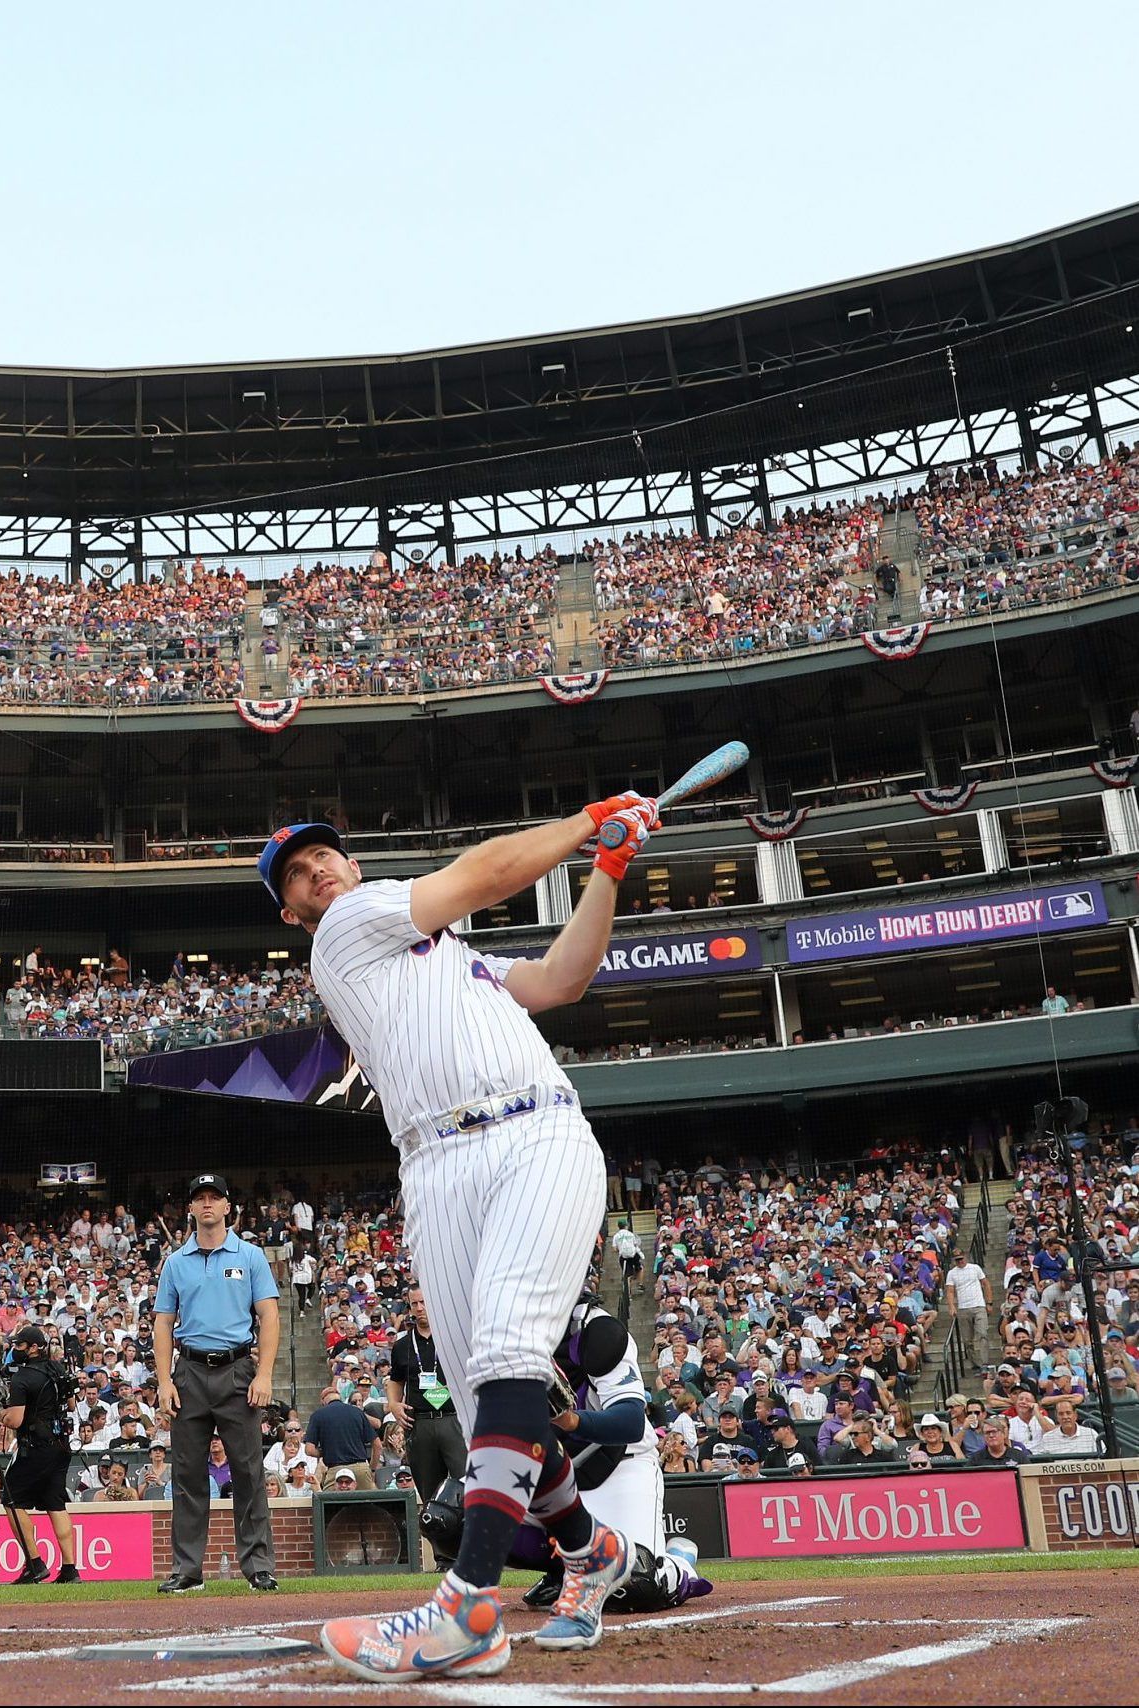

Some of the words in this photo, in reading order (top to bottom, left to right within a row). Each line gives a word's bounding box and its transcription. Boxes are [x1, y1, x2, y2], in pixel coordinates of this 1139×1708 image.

[814, 925, 876, 948] Mobile
[878, 914, 934, 942] HOME
[934, 908, 978, 935] RUN
[979, 899, 1045, 931] DERBY
[631, 942, 709, 969] GAME
[1042, 1463, 1106, 1474] ROCKIES.COM
[810, 1488, 983, 1541] Mobile
